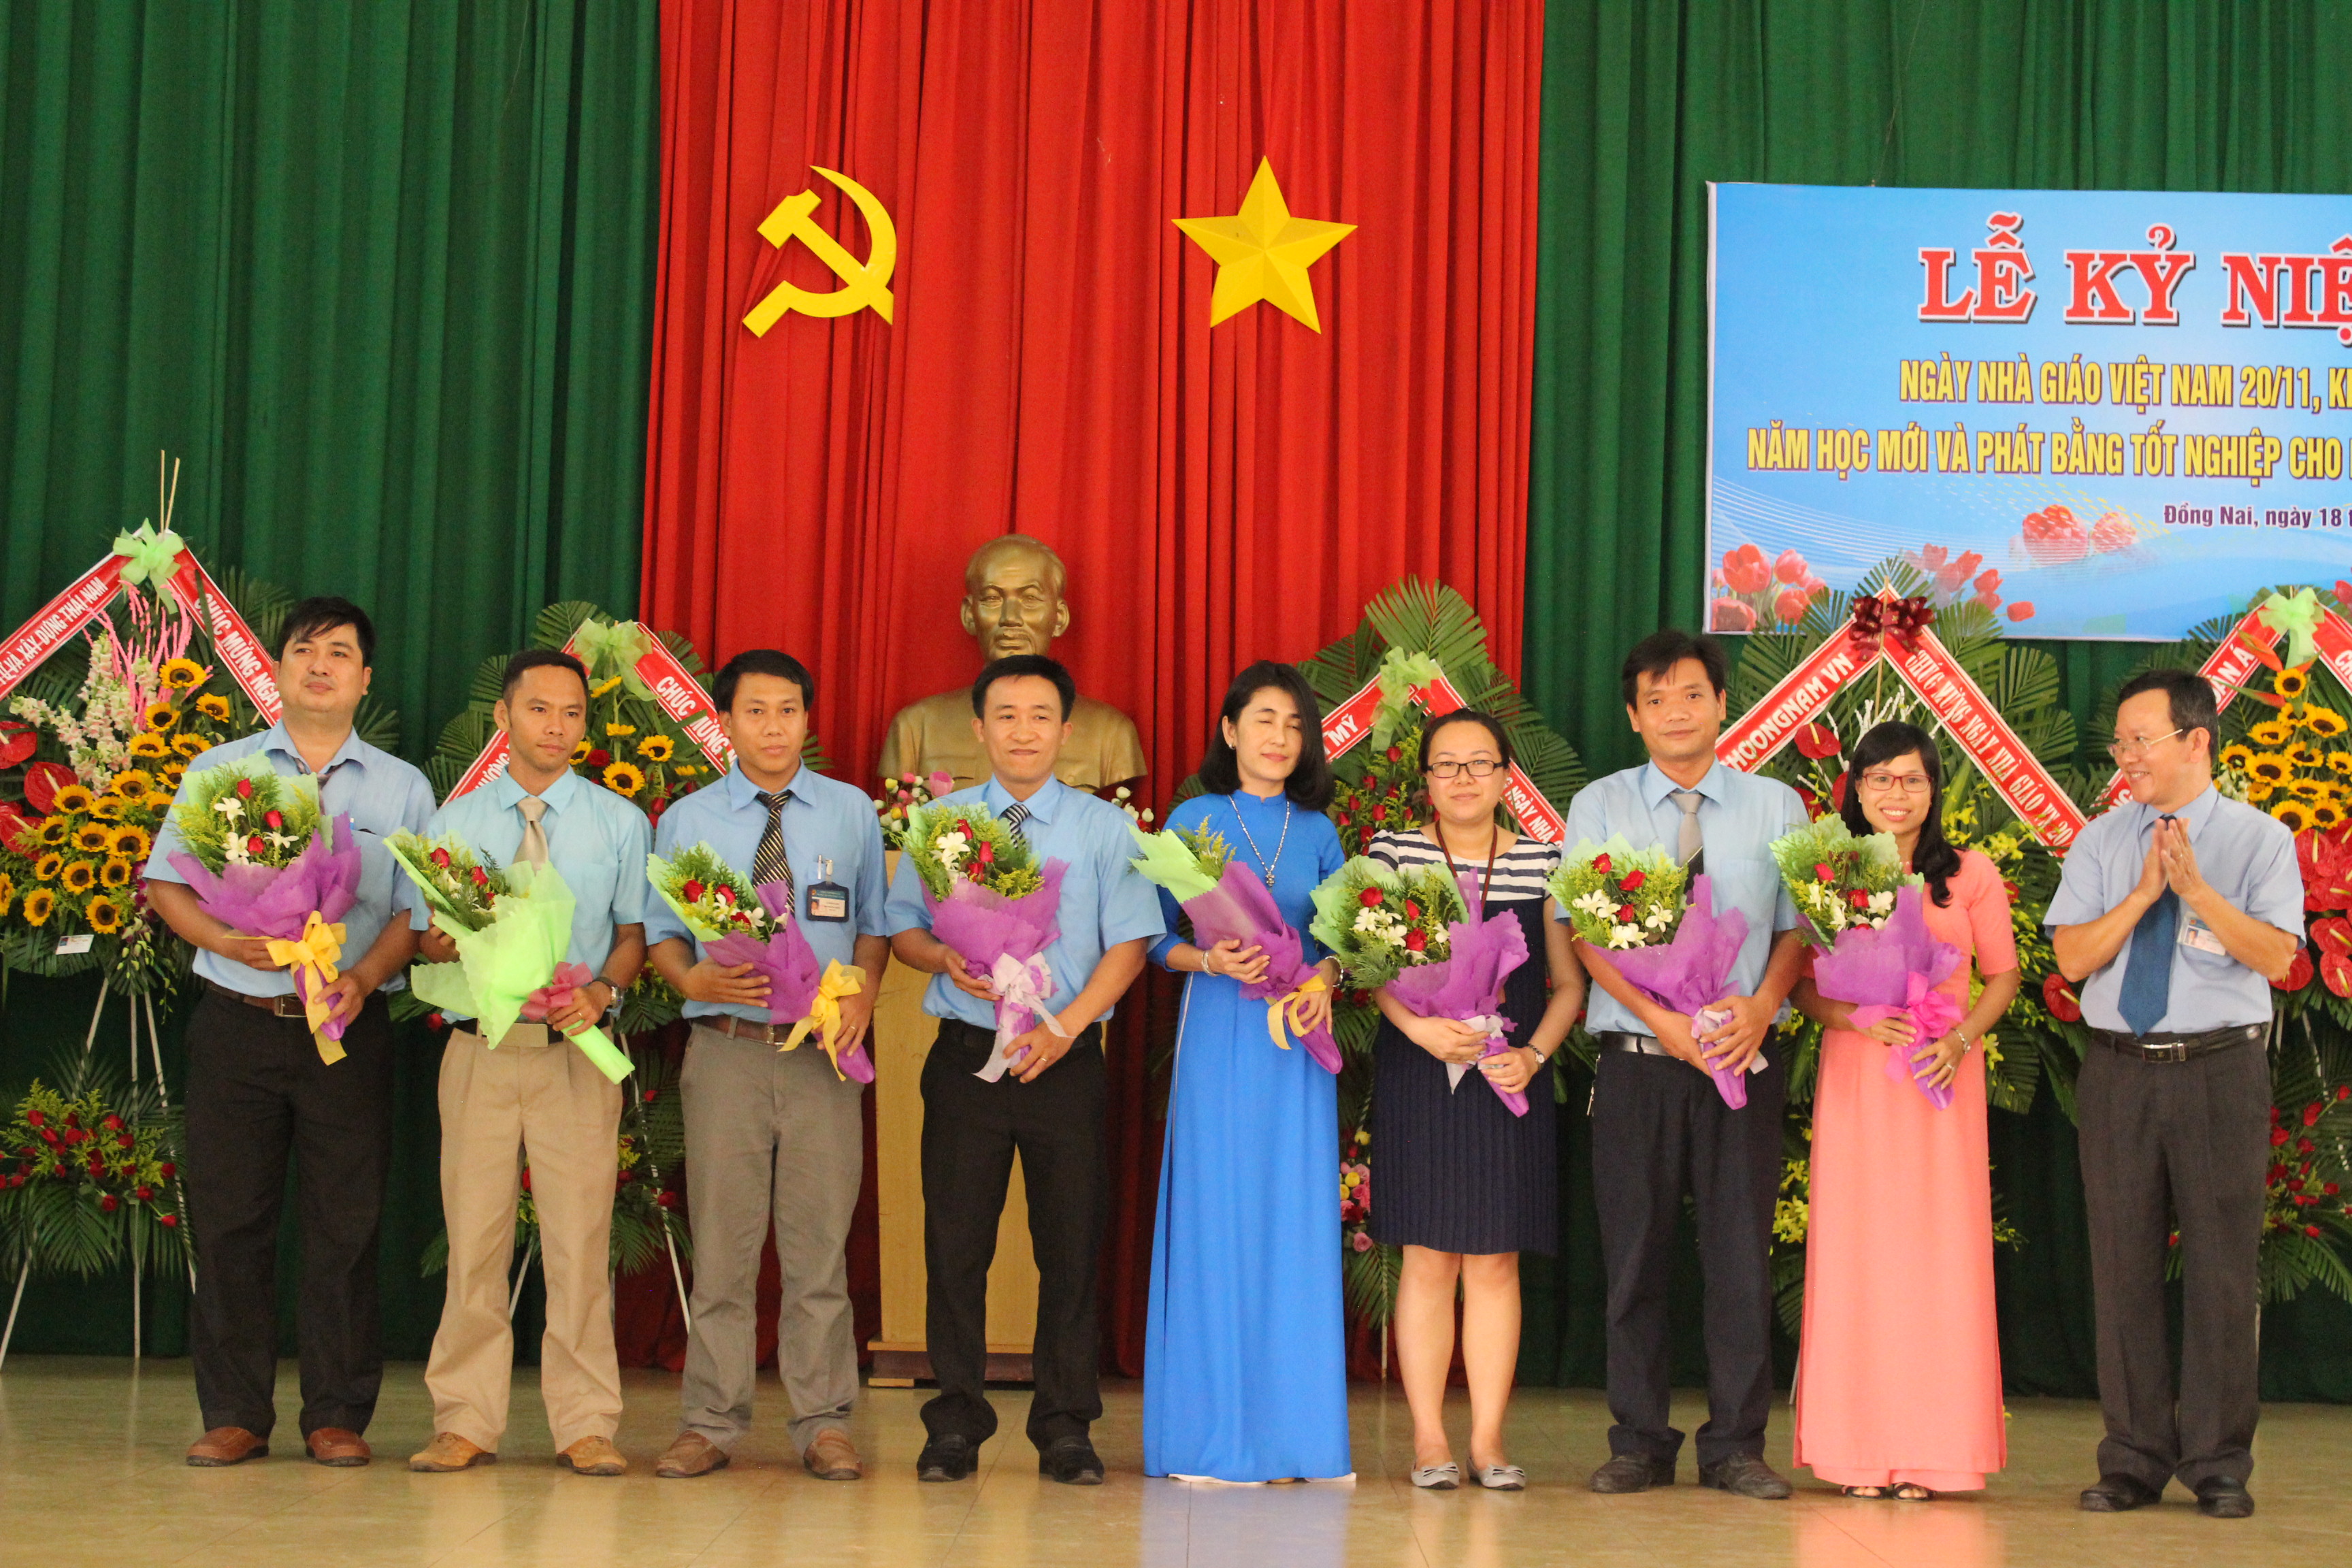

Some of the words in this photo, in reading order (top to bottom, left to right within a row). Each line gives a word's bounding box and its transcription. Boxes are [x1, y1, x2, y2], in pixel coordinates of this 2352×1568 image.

[1918, 210, 2036, 323] LỄ
[2063, 223, 2195, 325] KỶ
[1900, 351, 1972, 402] NGÀY
[1977, 353, 2034, 404] NHÀ
[2040, 353, 2102, 405] GIÁO
[2108, 355, 2164, 414] VIỆT
[2171, 364, 2233, 407] NAM
[2240, 365, 2321, 414] 20/11,
[1748, 420, 1810, 472] NĂM
[1816, 429, 1870, 481] HỌC
[1877, 422, 1929, 473] MỚI
[1935, 422, 1971, 472] VÀ
[1976, 423, 2046, 474] PHÁT
[2051, 417, 2123, 475] BẰNG
[2130, 420, 2178, 476] TỐT
[2184, 427, 2283, 487] NGHIỆP
[2289, 437, 2342, 480] CHO
[2163, 502, 2213, 527] Đồng
[2219, 506, 2259, 528] Nai,
[2265, 505, 2313, 529] ngày
[2319, 508, 2342, 527] 18
[3, 651, 26, 673] VÀ
[16, 637, 42, 662] XÂY
[35, 614, 69, 642] DỰNG
[58, 593, 88, 623] THÁI
[80, 576, 109, 604] NAM
[222, 631, 263, 679] MỪNG
[656, 676, 696, 717] CHÚC
[1720, 676, 1829, 772] HOONGNAM
[1820, 652, 1855, 684] VN
[1327, 713, 1358, 747] MỸ
[1905, 649, 1946, 690] CHÚC
[1930, 681, 1973, 723] MỪNG
[1959, 714, 2000, 755] NGÀY
[1985, 746, 2022, 783] NHÀ
[2009, 774, 2045, 811] GIÁO
[2034, 803, 2061, 829] VN
[1505, 785, 1538, 819] NGÀY
[1528, 815, 1558, 844] NHÀ
